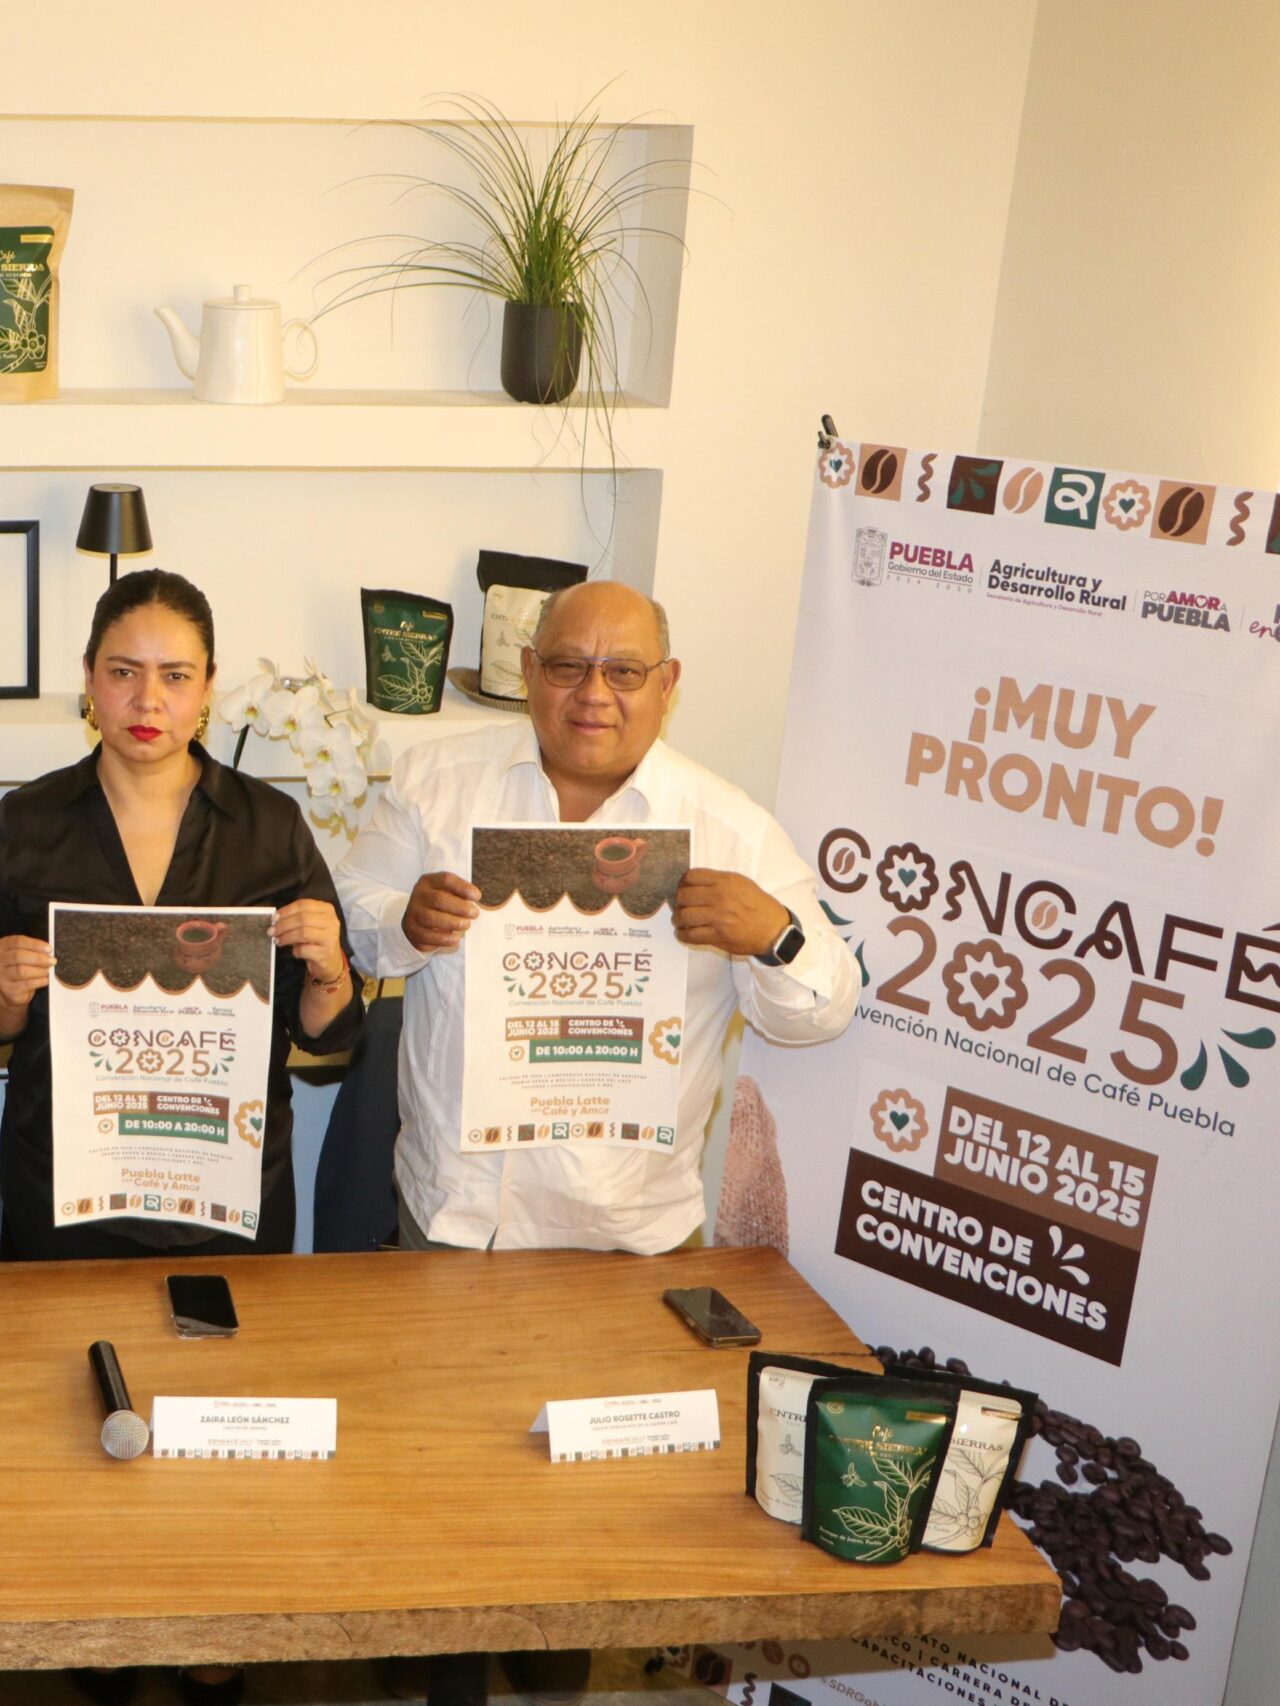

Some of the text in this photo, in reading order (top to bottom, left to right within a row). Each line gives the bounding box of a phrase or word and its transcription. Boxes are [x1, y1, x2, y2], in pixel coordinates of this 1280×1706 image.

[889, 541, 974, 573] PUEBLA
[888, 561, 973, 583] Gobierno del Estado
[990, 559, 1102, 593] Agricultura y
[988, 574, 1075, 602] Desarrollo
[1079, 589, 1126, 611] Rural
[1144, 591, 1166, 601] POR
[1165, 591, 1220, 611] AMOR
[1141, 601, 1230, 632] PUEBLA
[968, 675, 1157, 760] ¡MUY
[905, 731, 1224, 857] PRONTO!
[503, 949, 652, 972] CONCAFÉ
[528, 971, 624, 999] 2025
[876, 914, 1186, 1086] 2025
[88, 1028, 236, 1052] CONCAFÉ
[568, 1028, 632, 1036] CONVENCIONES
[115, 1047, 211, 1077] 2025
[536, 1046, 638, 1056] DE 10:00 A 20:00 H
[944, 1029, 1041, 1076] Nacional
[1047, 1064, 1076, 1087] de
[1084, 1073, 1141, 1107] Café
[1148, 1092, 1236, 1137] Puebla
[157, 1095, 202, 1104] CENTRO DE
[157, 1103, 219, 1115] CONVENCIONES
[530, 1096, 610, 1106] Puebla Latte
[543, 1107, 609, 1116] Café y Amor
[125, 1120, 224, 1136] DE 10:00 A 20:00 H
[948, 1105, 1146, 1196] DEL 12 AL 15
[121, 1168, 200, 1183] Puebla Latte
[134, 1177, 200, 1192] Café y Amor
[944, 1139, 1141, 1227] JUNIO 2025
[861, 1180, 1033, 1265] CENTRO DE
[856, 1213, 1108, 1330] CONVENCIONES
[200, 1414, 290, 1424] ZAIRA LEÓN SÁNCHEZ
[589, 1416, 611, 1425] JULIO
[613, 1412, 647, 1423] ROSETTE
[649, 1410, 680, 1419] CASTRO
[852, 1637, 985, 1706] APACITACIONES
[930, 1655, 1002, 1699] CARRERA
[957, 1652, 1041, 1700] NACIONAL
